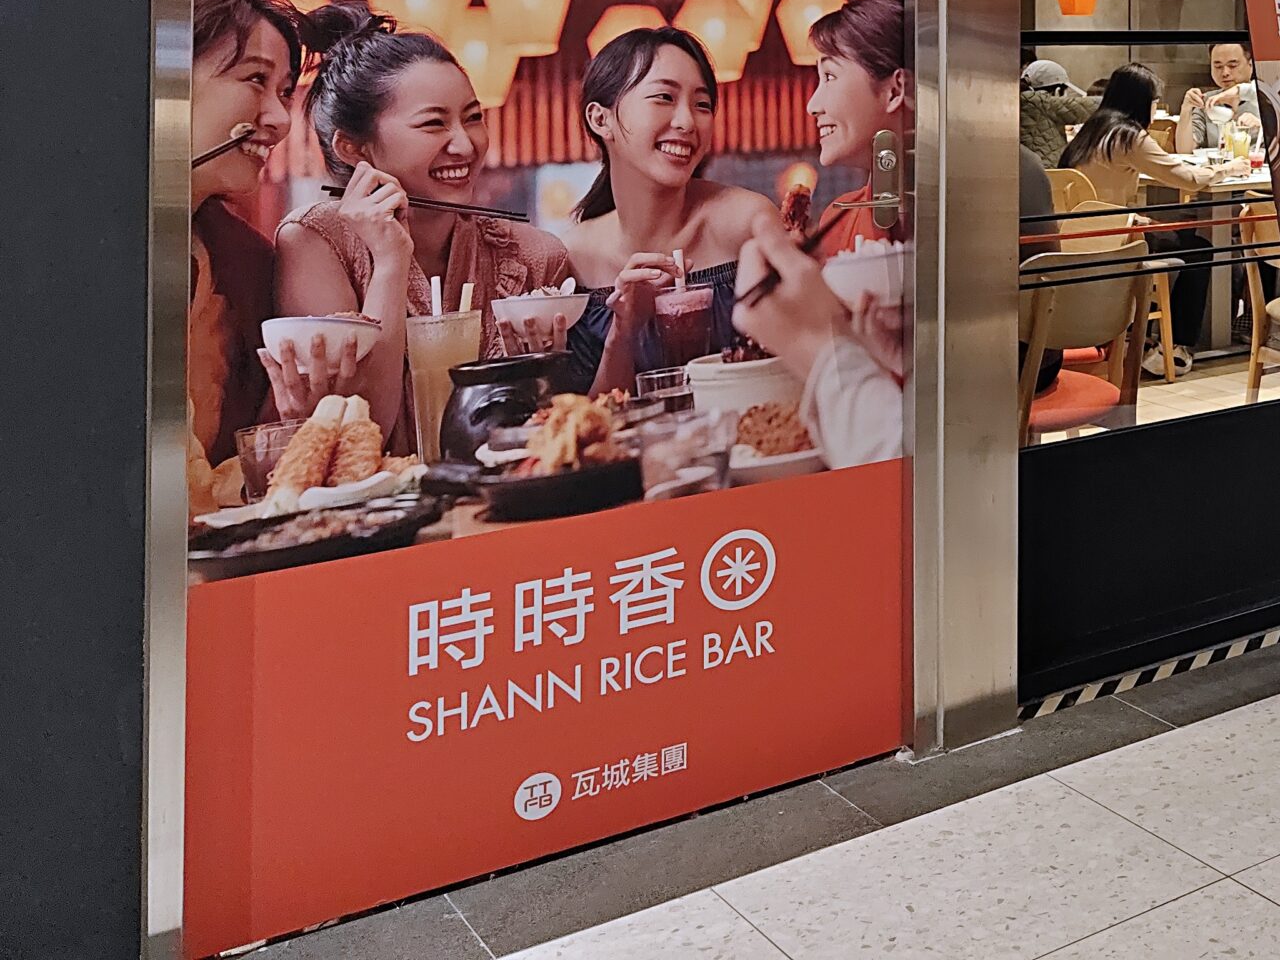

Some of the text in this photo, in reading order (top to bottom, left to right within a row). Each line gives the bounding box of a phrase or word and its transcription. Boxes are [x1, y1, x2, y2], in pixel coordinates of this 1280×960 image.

[408, 547, 685, 676] 時時香
[406, 620, 776, 742] SHANN RICE BAR
[571, 742, 687, 800] 瓦城集團
